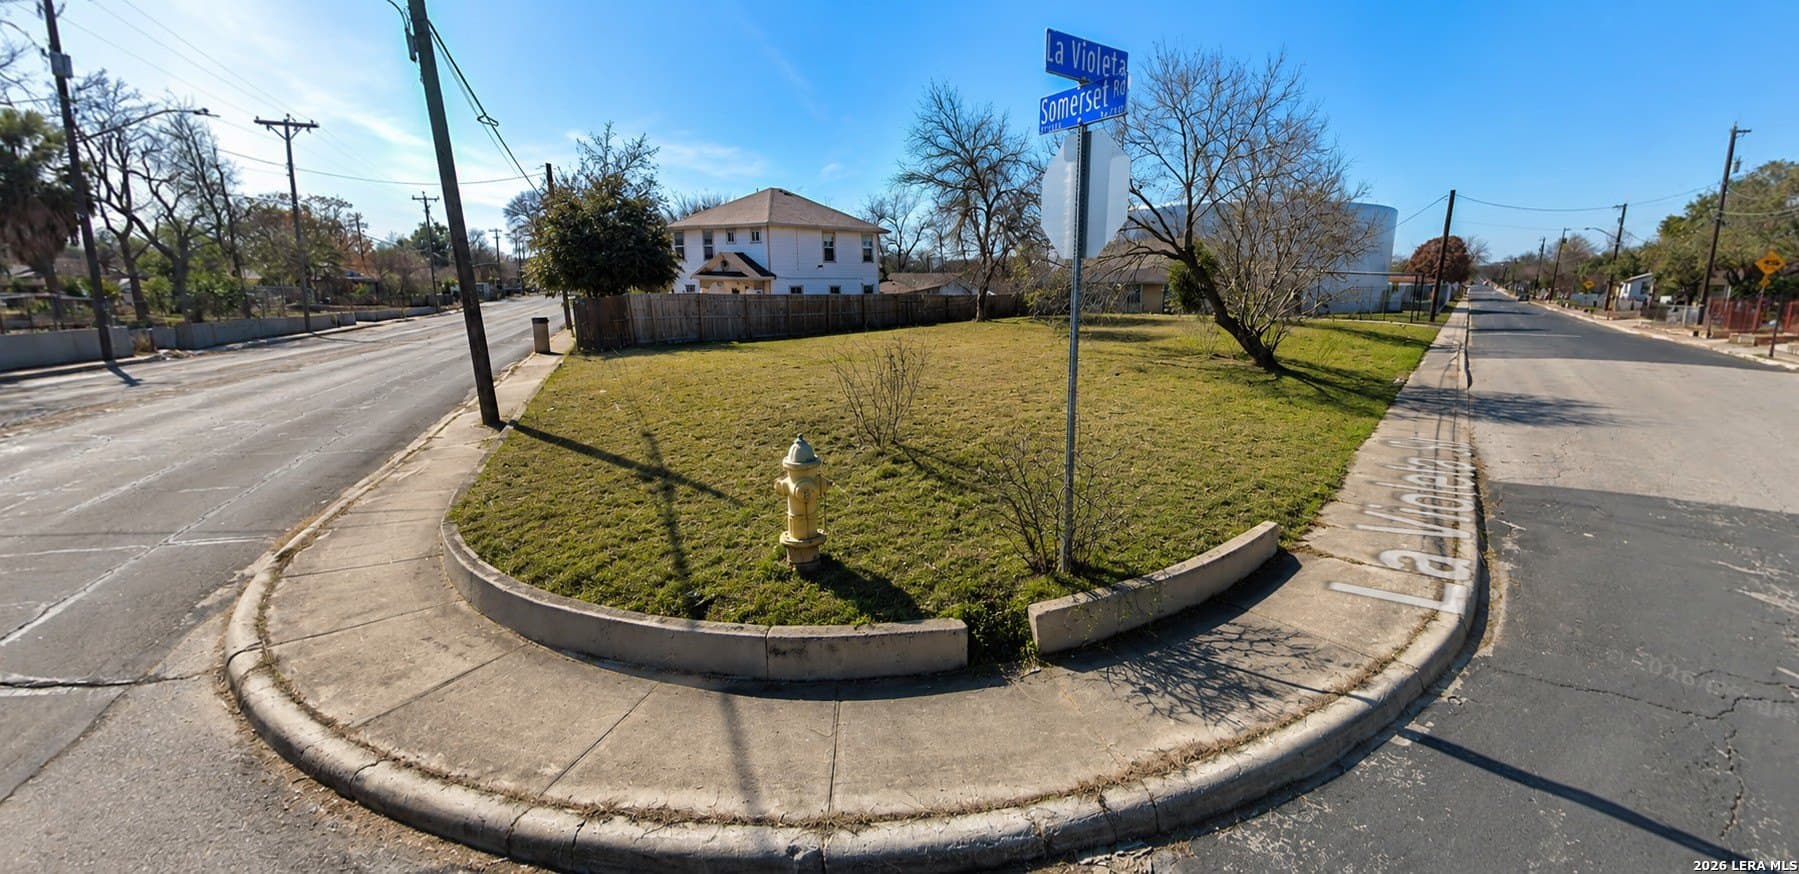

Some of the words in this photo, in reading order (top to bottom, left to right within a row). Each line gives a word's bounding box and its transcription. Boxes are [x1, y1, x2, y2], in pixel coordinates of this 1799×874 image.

[1047, 32, 1064, 65] La
[1072, 40, 1126, 77] Violeta
[1041, 80, 1109, 125] Somerset
[1113, 76, 1126, 98] Rd
